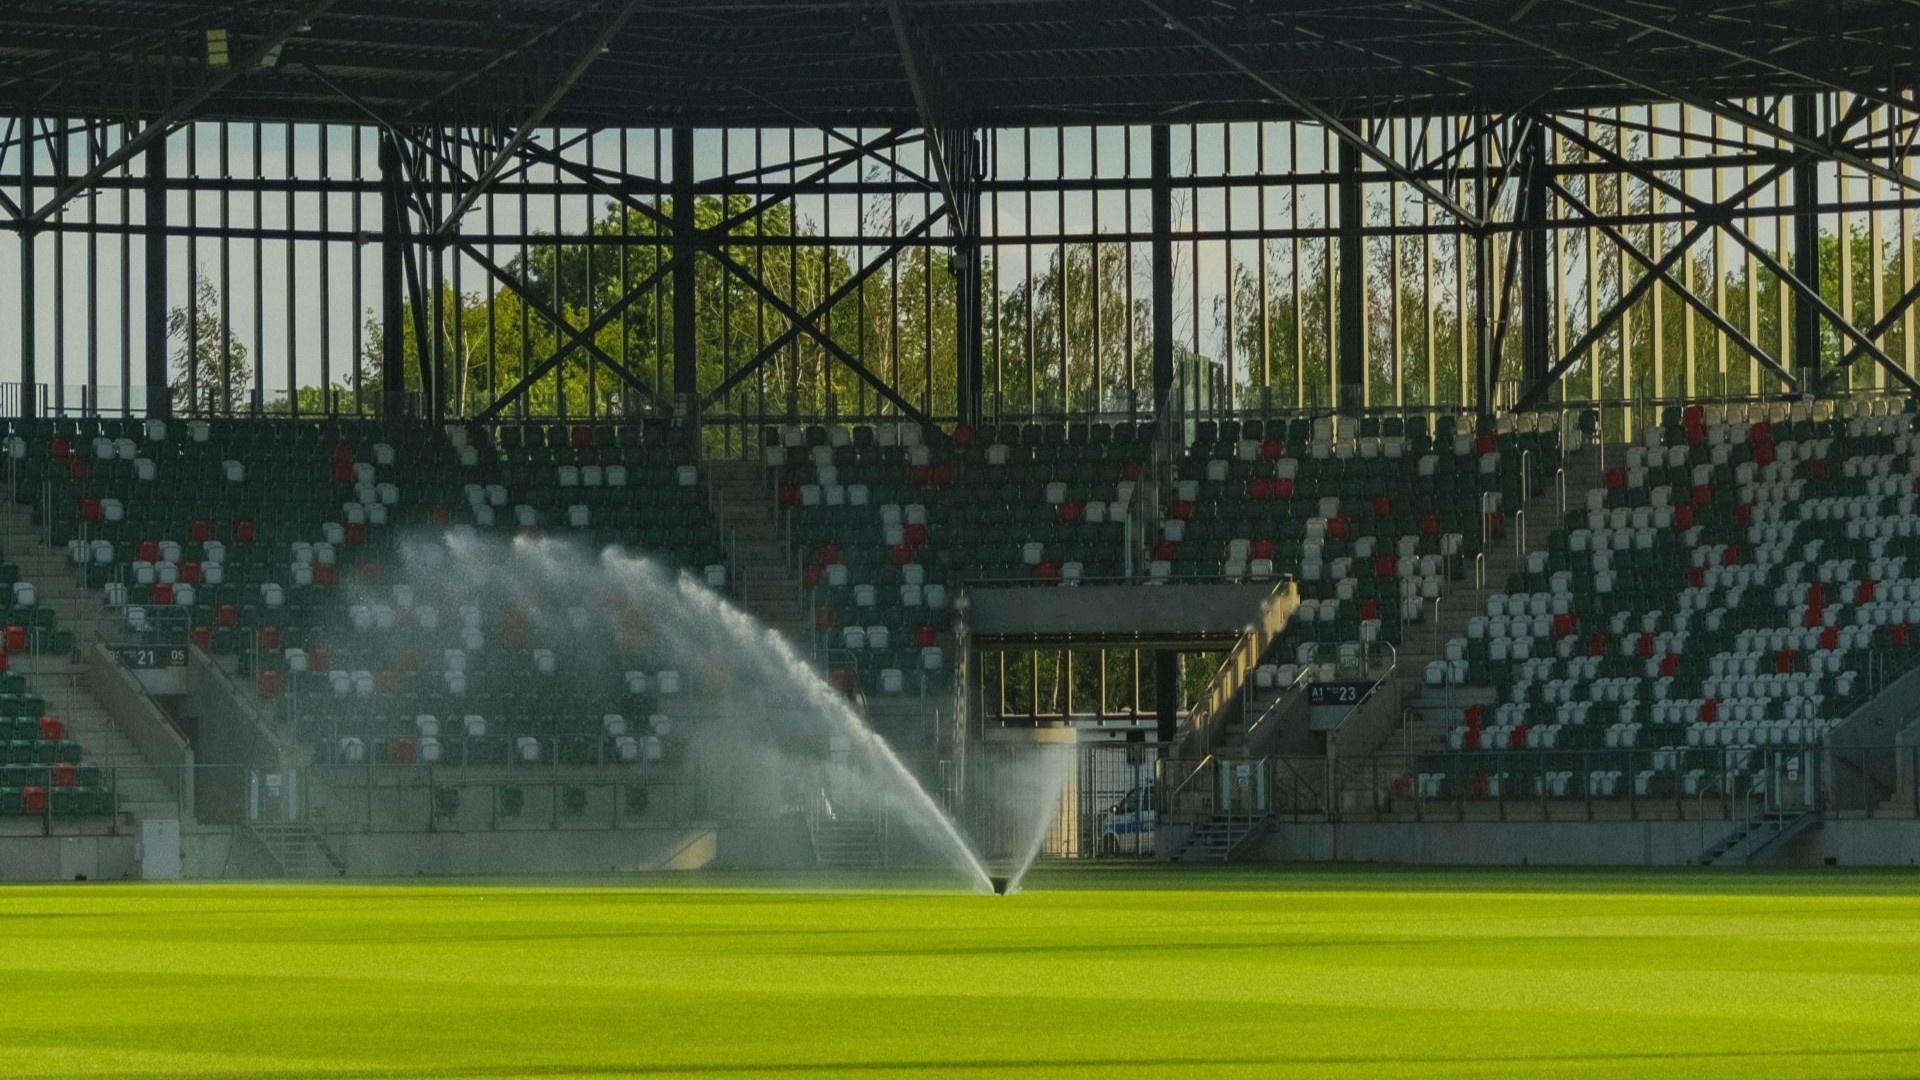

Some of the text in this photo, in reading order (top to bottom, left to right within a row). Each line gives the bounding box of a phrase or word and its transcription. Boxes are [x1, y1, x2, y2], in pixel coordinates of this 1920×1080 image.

[137, 650, 153, 665] 21
[1312, 687, 1323, 697] A1
[1339, 686, 1356, 701] 23
